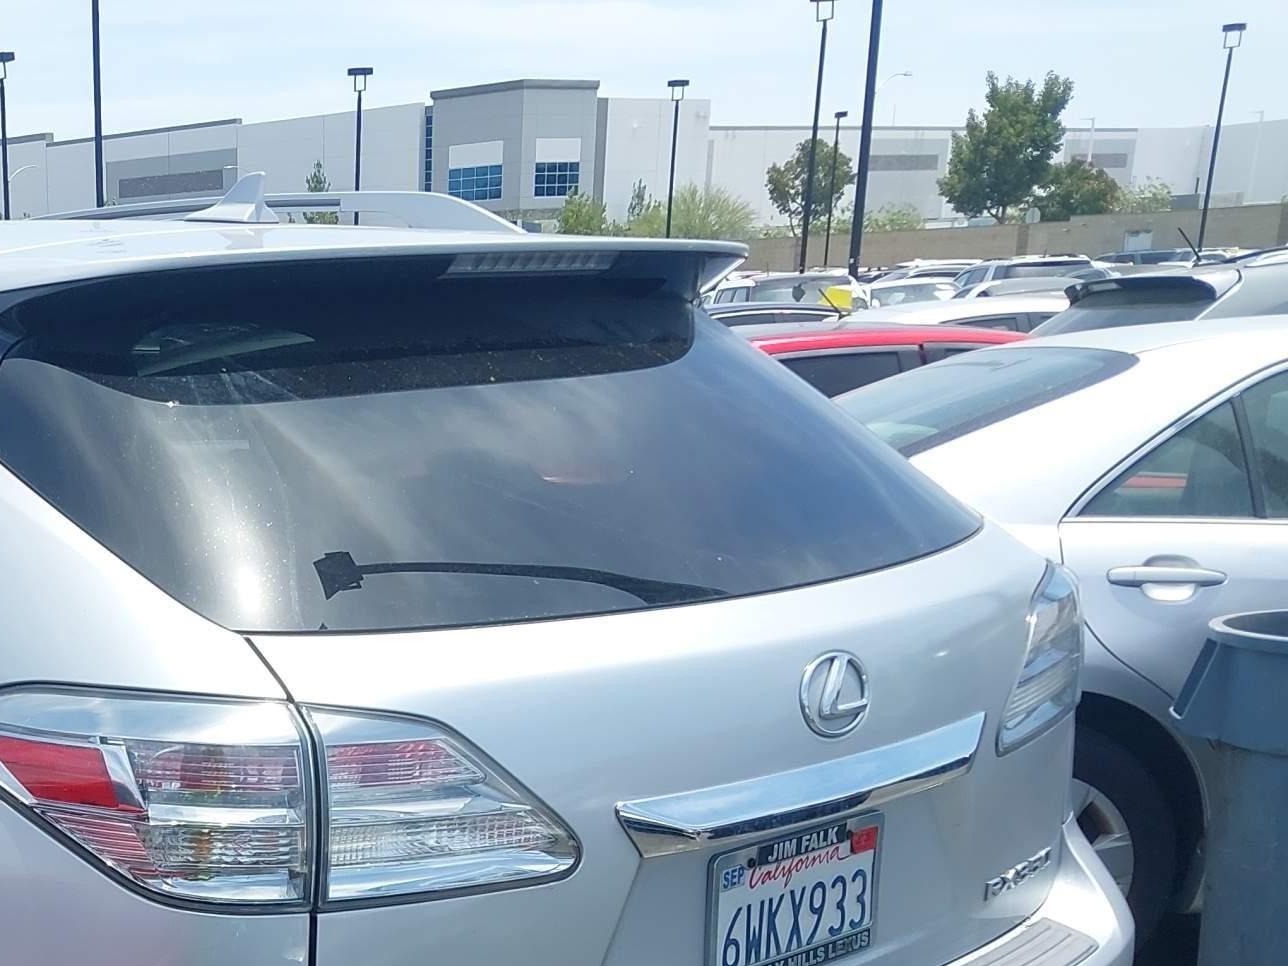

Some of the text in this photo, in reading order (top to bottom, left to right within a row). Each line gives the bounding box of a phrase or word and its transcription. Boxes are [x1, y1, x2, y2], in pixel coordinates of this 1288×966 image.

[768, 841, 798, 863] JIM
[800, 827, 840, 851] FALK
[722, 868, 745, 890] SEP
[749, 846, 850, 890] California
[828, 931, 870, 964] LEXUS
